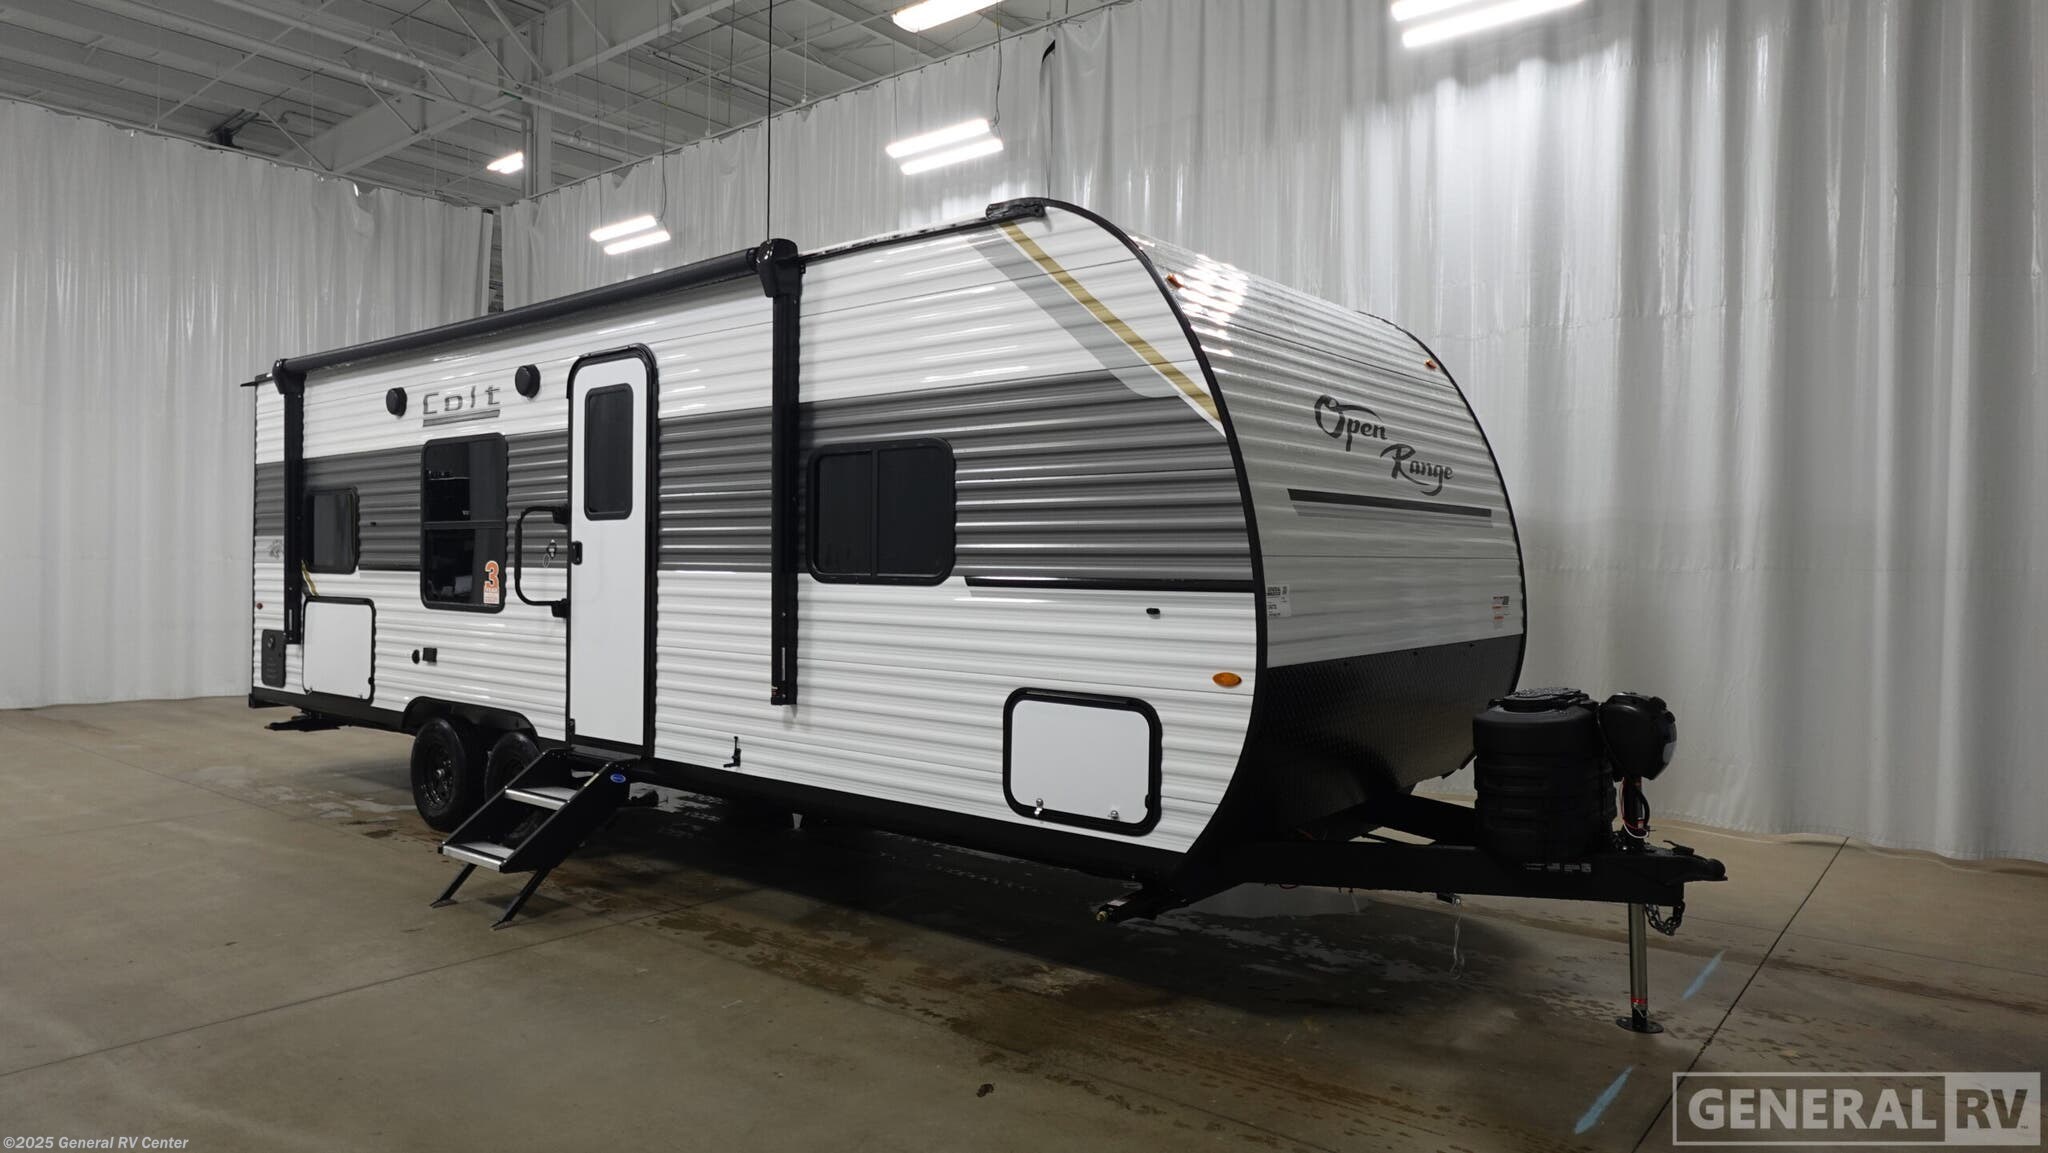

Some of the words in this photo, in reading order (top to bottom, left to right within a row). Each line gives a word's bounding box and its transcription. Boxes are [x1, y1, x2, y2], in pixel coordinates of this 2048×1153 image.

[423, 385, 501, 415] Colt
[1314, 394, 1388, 452] Open
[1380, 443, 1454, 497] Range
[485, 560, 500, 588] 3
